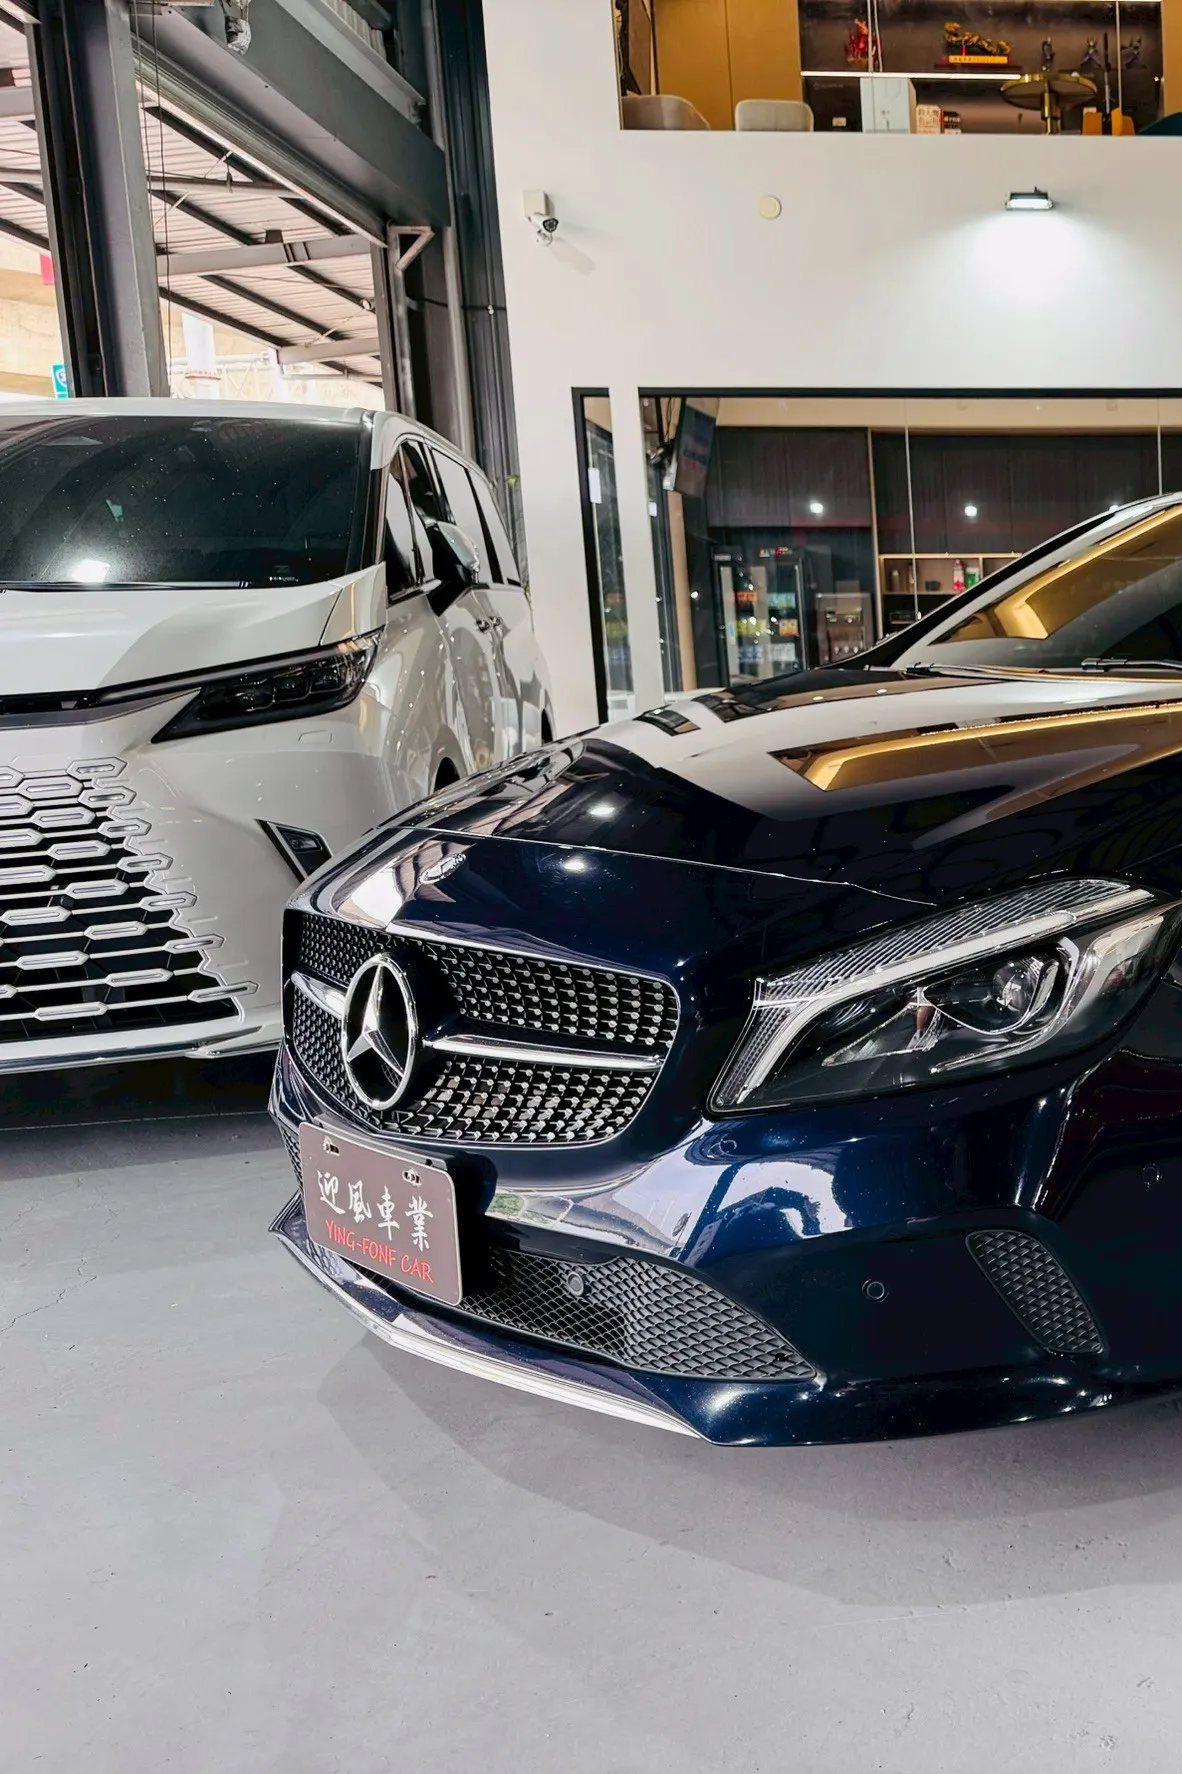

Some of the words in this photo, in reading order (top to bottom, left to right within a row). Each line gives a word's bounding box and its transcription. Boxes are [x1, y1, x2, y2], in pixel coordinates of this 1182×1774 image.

[317, 1170, 433, 1251] 迎風車業
[400, 1253, 433, 1283] CAR
